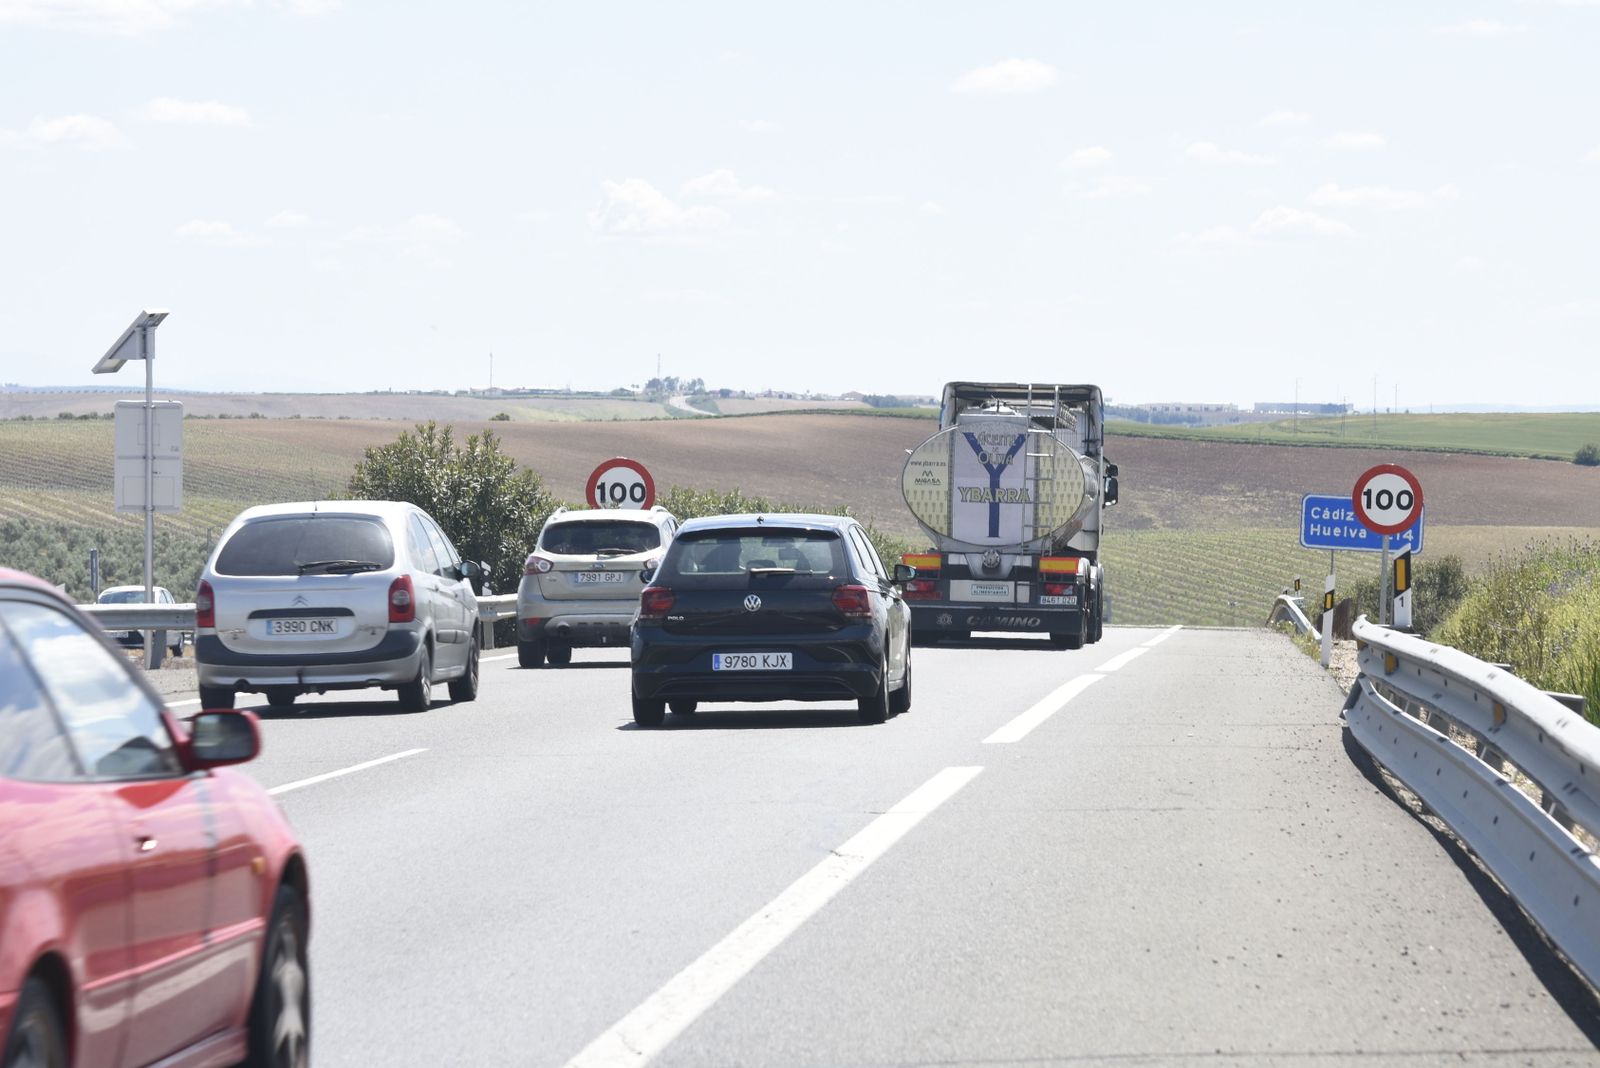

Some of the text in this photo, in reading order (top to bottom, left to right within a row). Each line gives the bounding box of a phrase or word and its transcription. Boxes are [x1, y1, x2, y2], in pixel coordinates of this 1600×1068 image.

[596, 482, 646, 504] 100
[958, 486, 1031, 504] YBARRA
[1363, 488, 1414, 511] 100
[1310, 507, 1355, 522] Cádiz
[1310, 524, 1367, 539] Huelva
[580, 573, 622, 582] 7991 GPJ
[1399, 596, 1405, 608] 1
[275, 619, 334, 633] 3990 CNK
[724, 654, 787, 668] 9780 KJX
